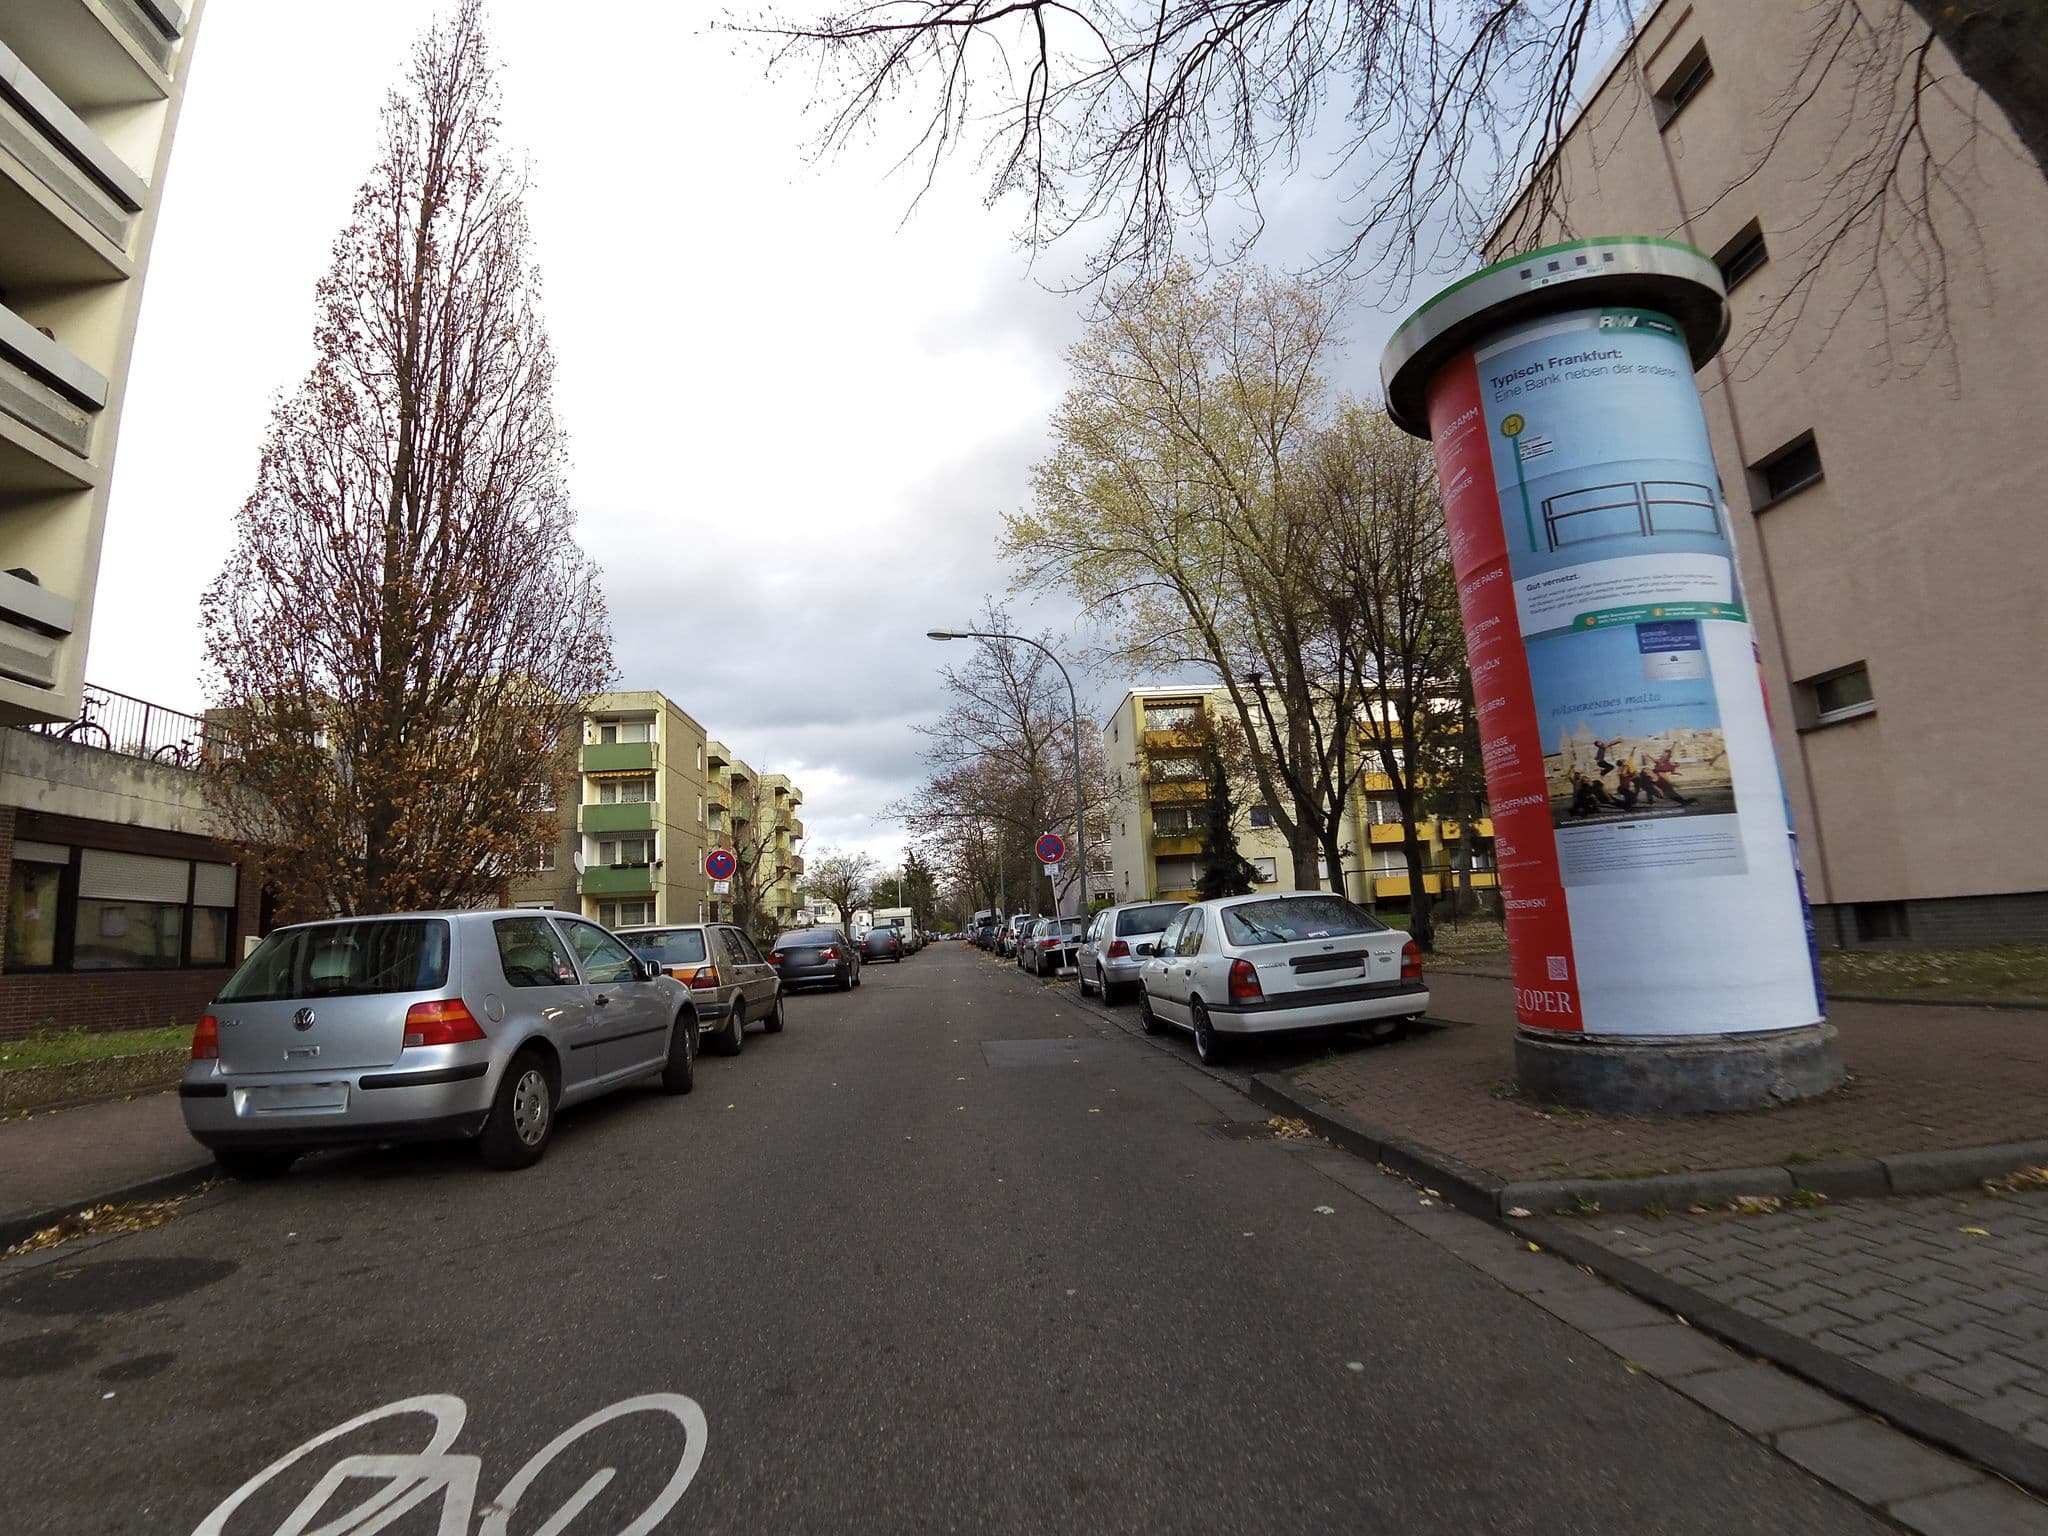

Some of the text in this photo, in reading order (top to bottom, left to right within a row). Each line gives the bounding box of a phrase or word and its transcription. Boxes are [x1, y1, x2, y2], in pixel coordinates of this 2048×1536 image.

[1599, 315, 1639, 328] RMV
[1490, 348, 1623, 389] Typisch Frankfurt:
[1495, 385, 1522, 403] Eine
[1525, 373, 1561, 392] Bank
[1564, 366, 1609, 381] neben
[1612, 362, 1634, 375] der
[1482, 568, 1504, 585] PARIS
[1526, 574, 1580, 592] Gut vernetzt.
[1523, 990, 1573, 1014] OPER
